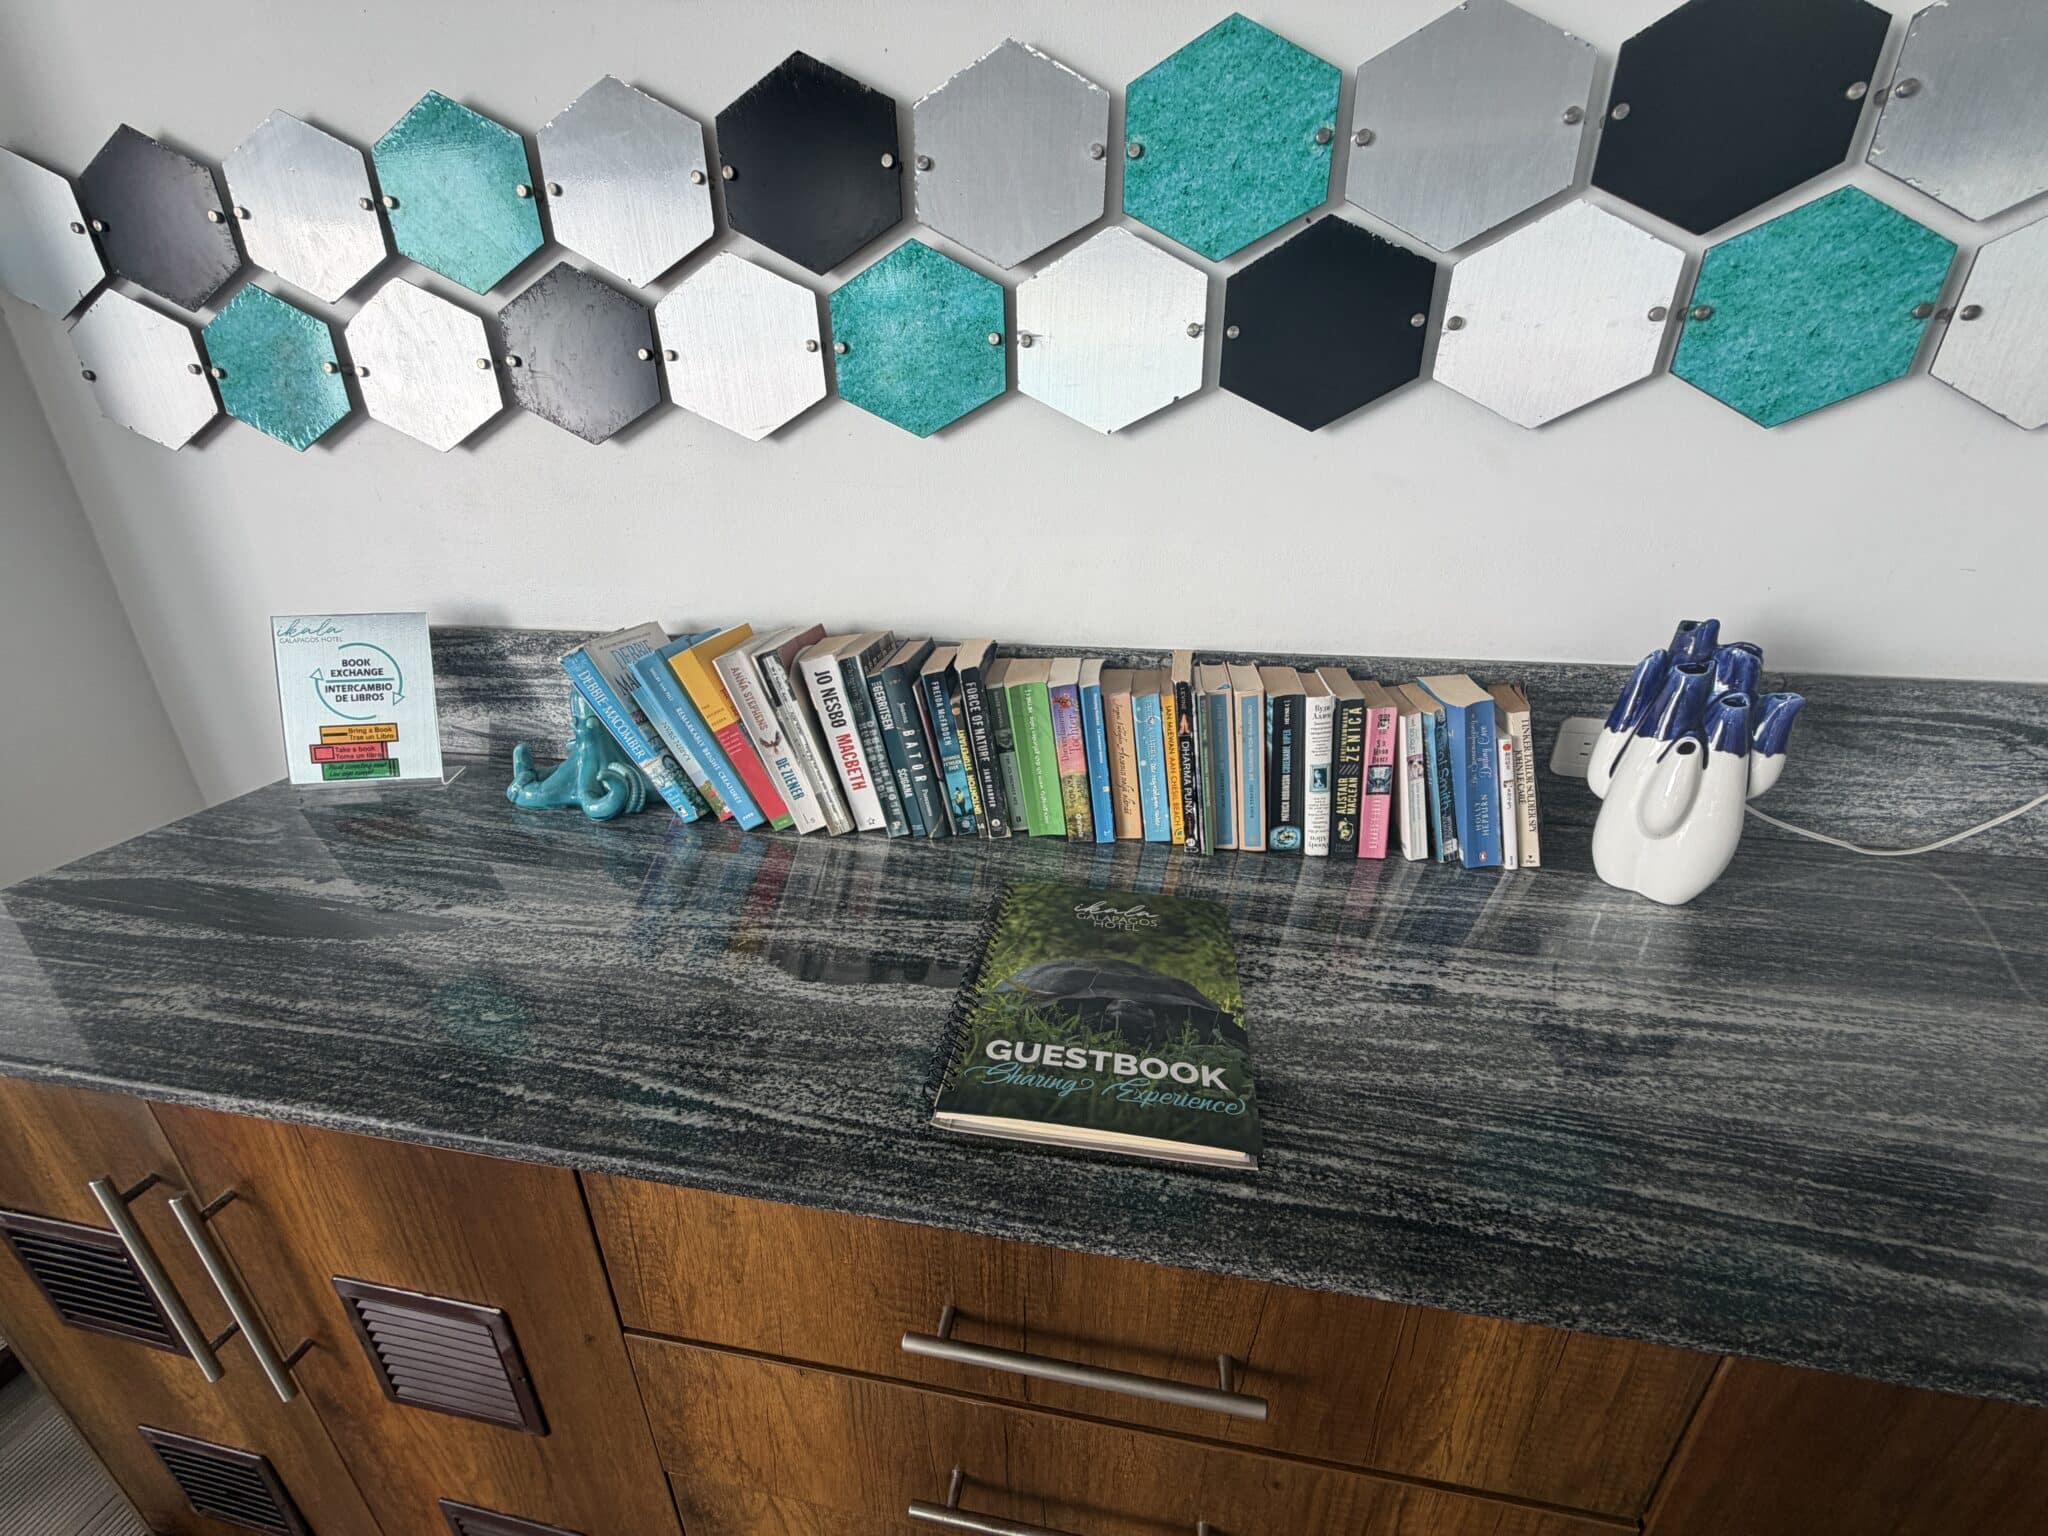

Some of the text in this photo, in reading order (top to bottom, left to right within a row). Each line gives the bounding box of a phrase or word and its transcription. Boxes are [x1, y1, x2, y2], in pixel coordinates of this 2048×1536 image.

[330, 668, 384, 677] EXCHANGE
[342, 659, 371, 667] BOOK
[813, 667, 833, 686] JO
[325, 683, 393, 693] INTERCAMBIO
[335, 693, 385, 703] DE LIBROS
[729, 665, 749, 692] ANNA
[742, 690, 768, 731] STEPHENS
[818, 686, 848, 729] NESBØ
[872, 684, 894, 731] GERRITSEN
[577, 668, 608, 706] DEBBIE
[602, 703, 647, 760] MACOMBER
[930, 680, 952, 746] FREIDA McFADDEN
[964, 681, 990, 762] FORCE OF NATURE
[1164, 705, 1173, 720] IAN
[674, 706, 705, 748] REMARKABLY
[717, 770, 742, 804] CREATURES
[1166, 721, 1176, 754] McEWAN
[1346, 706, 1362, 762] ZENICA
[834, 732, 868, 792] MACBETH
[901, 728, 928, 783] BATOR
[1168, 756, 1177, 774] AAN
[1181, 741, 1191, 785] DHARMA
[1513, 749, 1524, 773] JOHN
[1521, 718, 1536, 832] TINKER TAILOR SOLDIER SPY
[775, 756, 805, 801] DE ZIENER
[982, 767, 997, 808] JANE HARPER
[1336, 777, 1348, 814] ALISTAIR
[1347, 776, 1358, 814] MACLEAN
[1436, 767, 1451, 810] Smith
[1172, 802, 1181, 826] BEACH
[1183, 787, 1193, 814] PUNX
[1076, 912, 1158, 927] GALAPAGOS
[1094, 920, 1140, 932] HOTEL
[985, 1039, 1230, 1091] GUESTBOOK
[965, 1061, 1247, 1116] Sharing Experience
